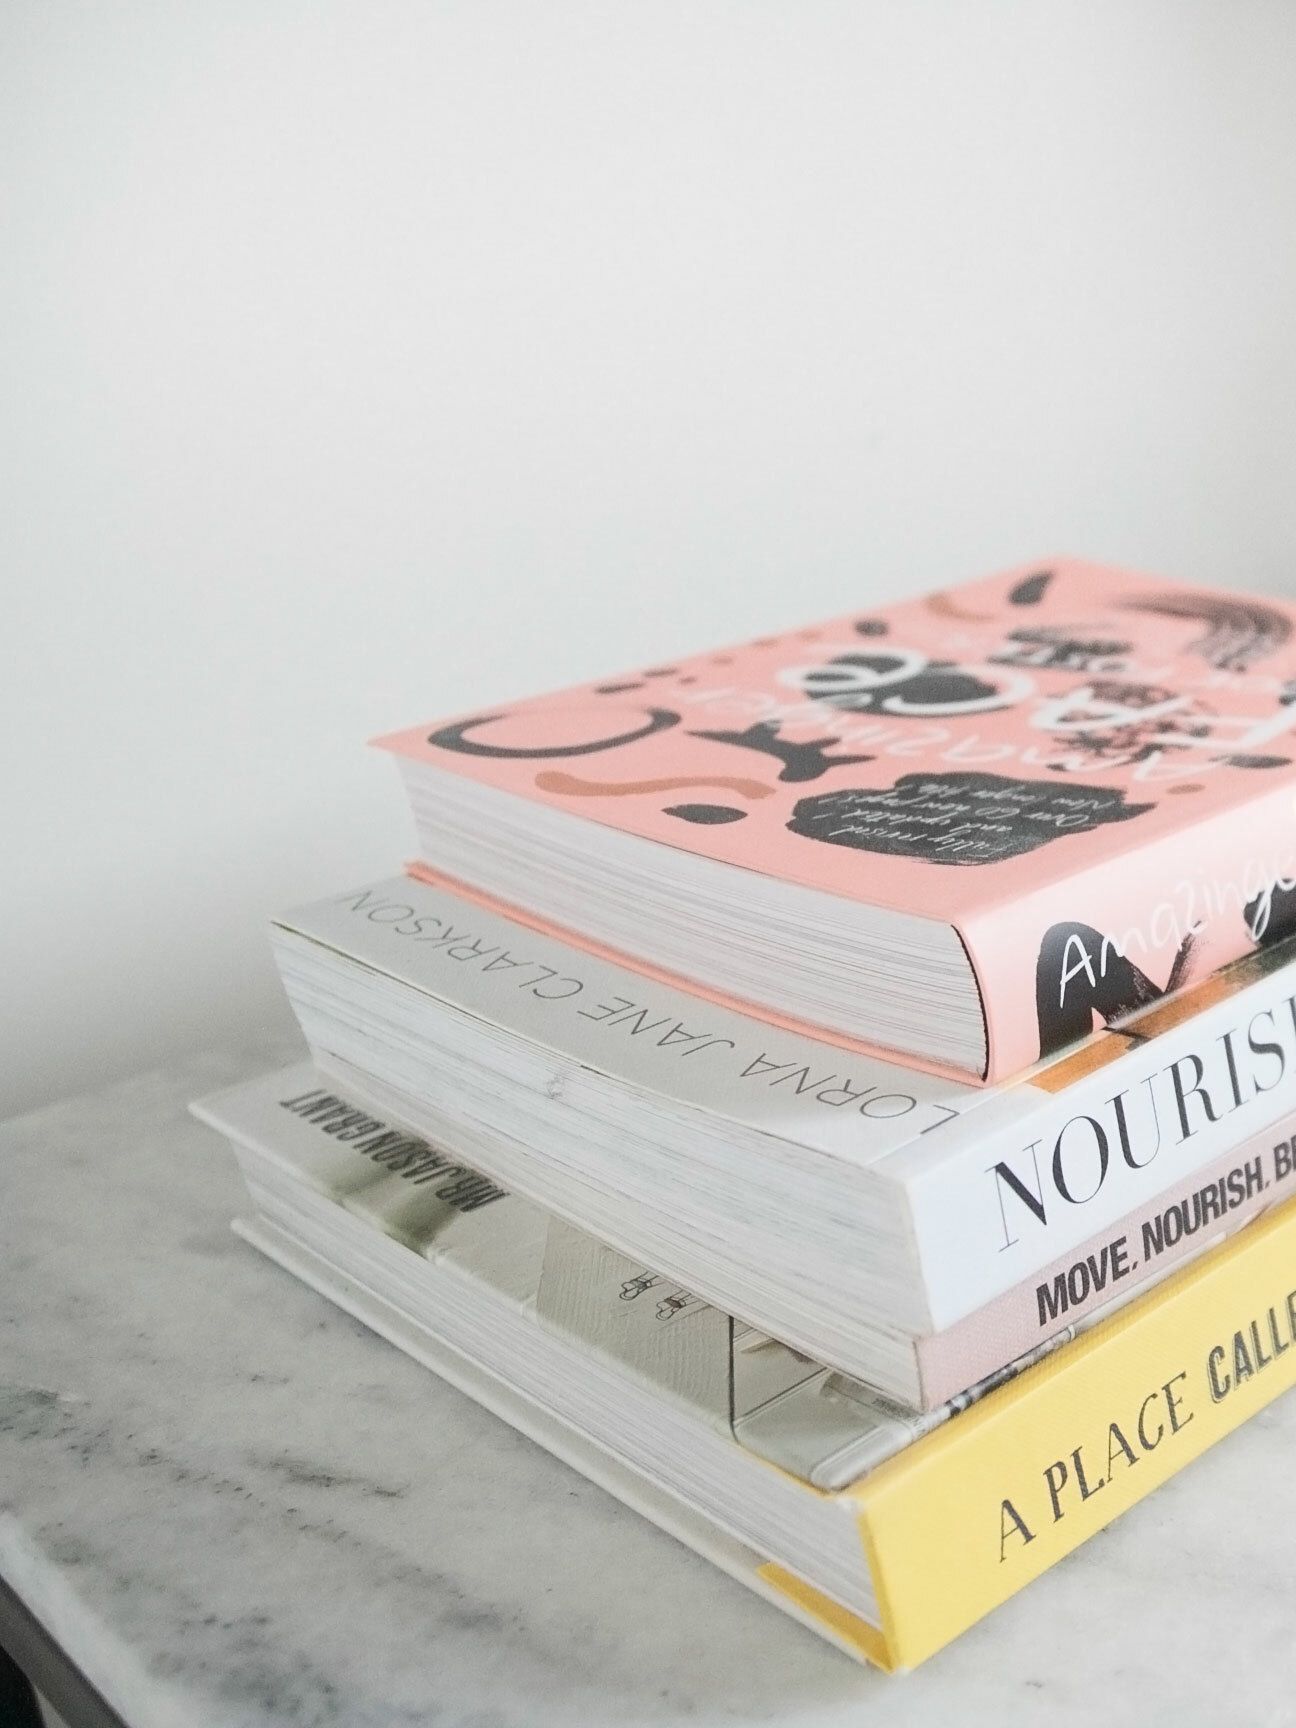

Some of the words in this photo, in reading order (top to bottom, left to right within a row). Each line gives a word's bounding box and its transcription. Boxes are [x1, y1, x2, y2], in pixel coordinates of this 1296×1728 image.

[350, 889, 584, 999] CLARKSON
[577, 997, 735, 1056] JANE
[280, 1089, 386, 1141] GRANT
[739, 1052, 960, 1134] LORNA
[353, 1131, 467, 1184] JASON
[435, 1169, 510, 1213] MR
[1035, 1236, 1139, 1327] MOVE.
[1141, 1155, 1271, 1262] NOURISH.
[999, 1499, 1036, 1563] A
[1042, 1371, 1194, 1524] PLACE
